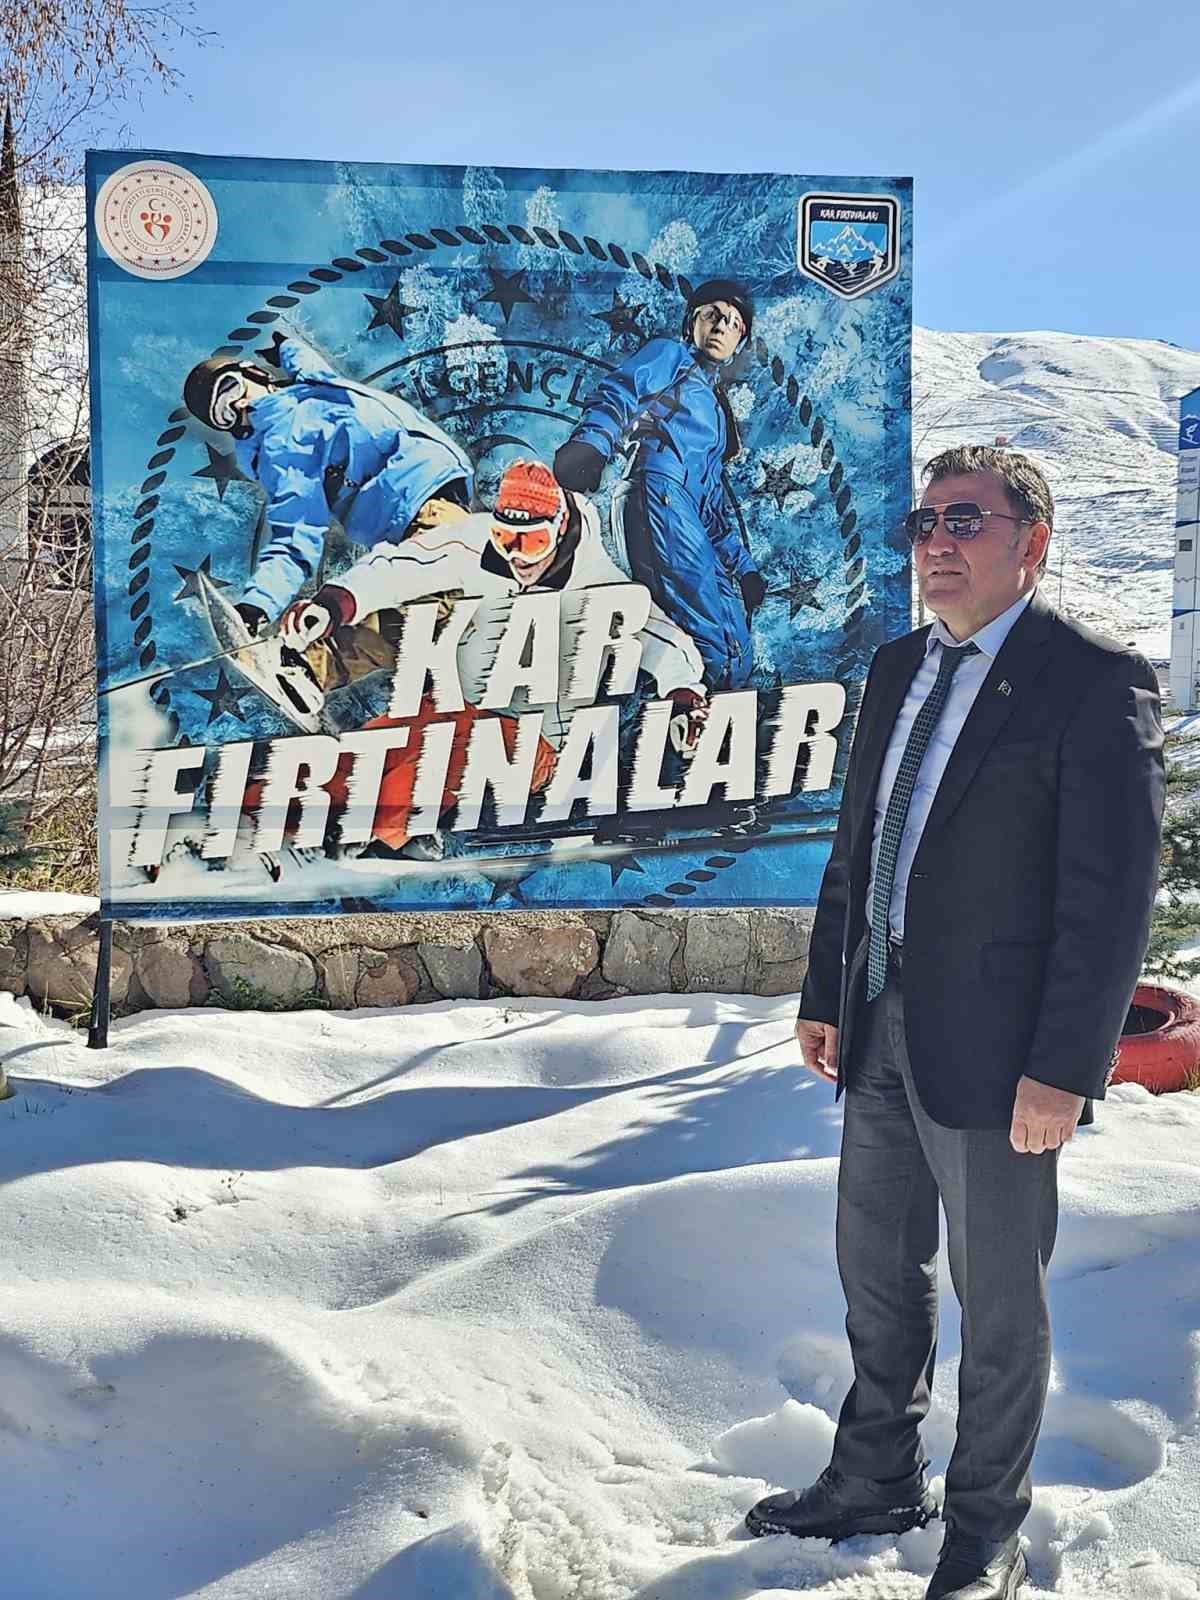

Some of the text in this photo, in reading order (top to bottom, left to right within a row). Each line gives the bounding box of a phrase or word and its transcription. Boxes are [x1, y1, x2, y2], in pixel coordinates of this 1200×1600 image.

[820, 208, 835, 219] KAR
[441, 360, 590, 409] GENÇL
[387, 582, 652, 718] KAR
[126, 678, 864, 868] FIRTINALAR
